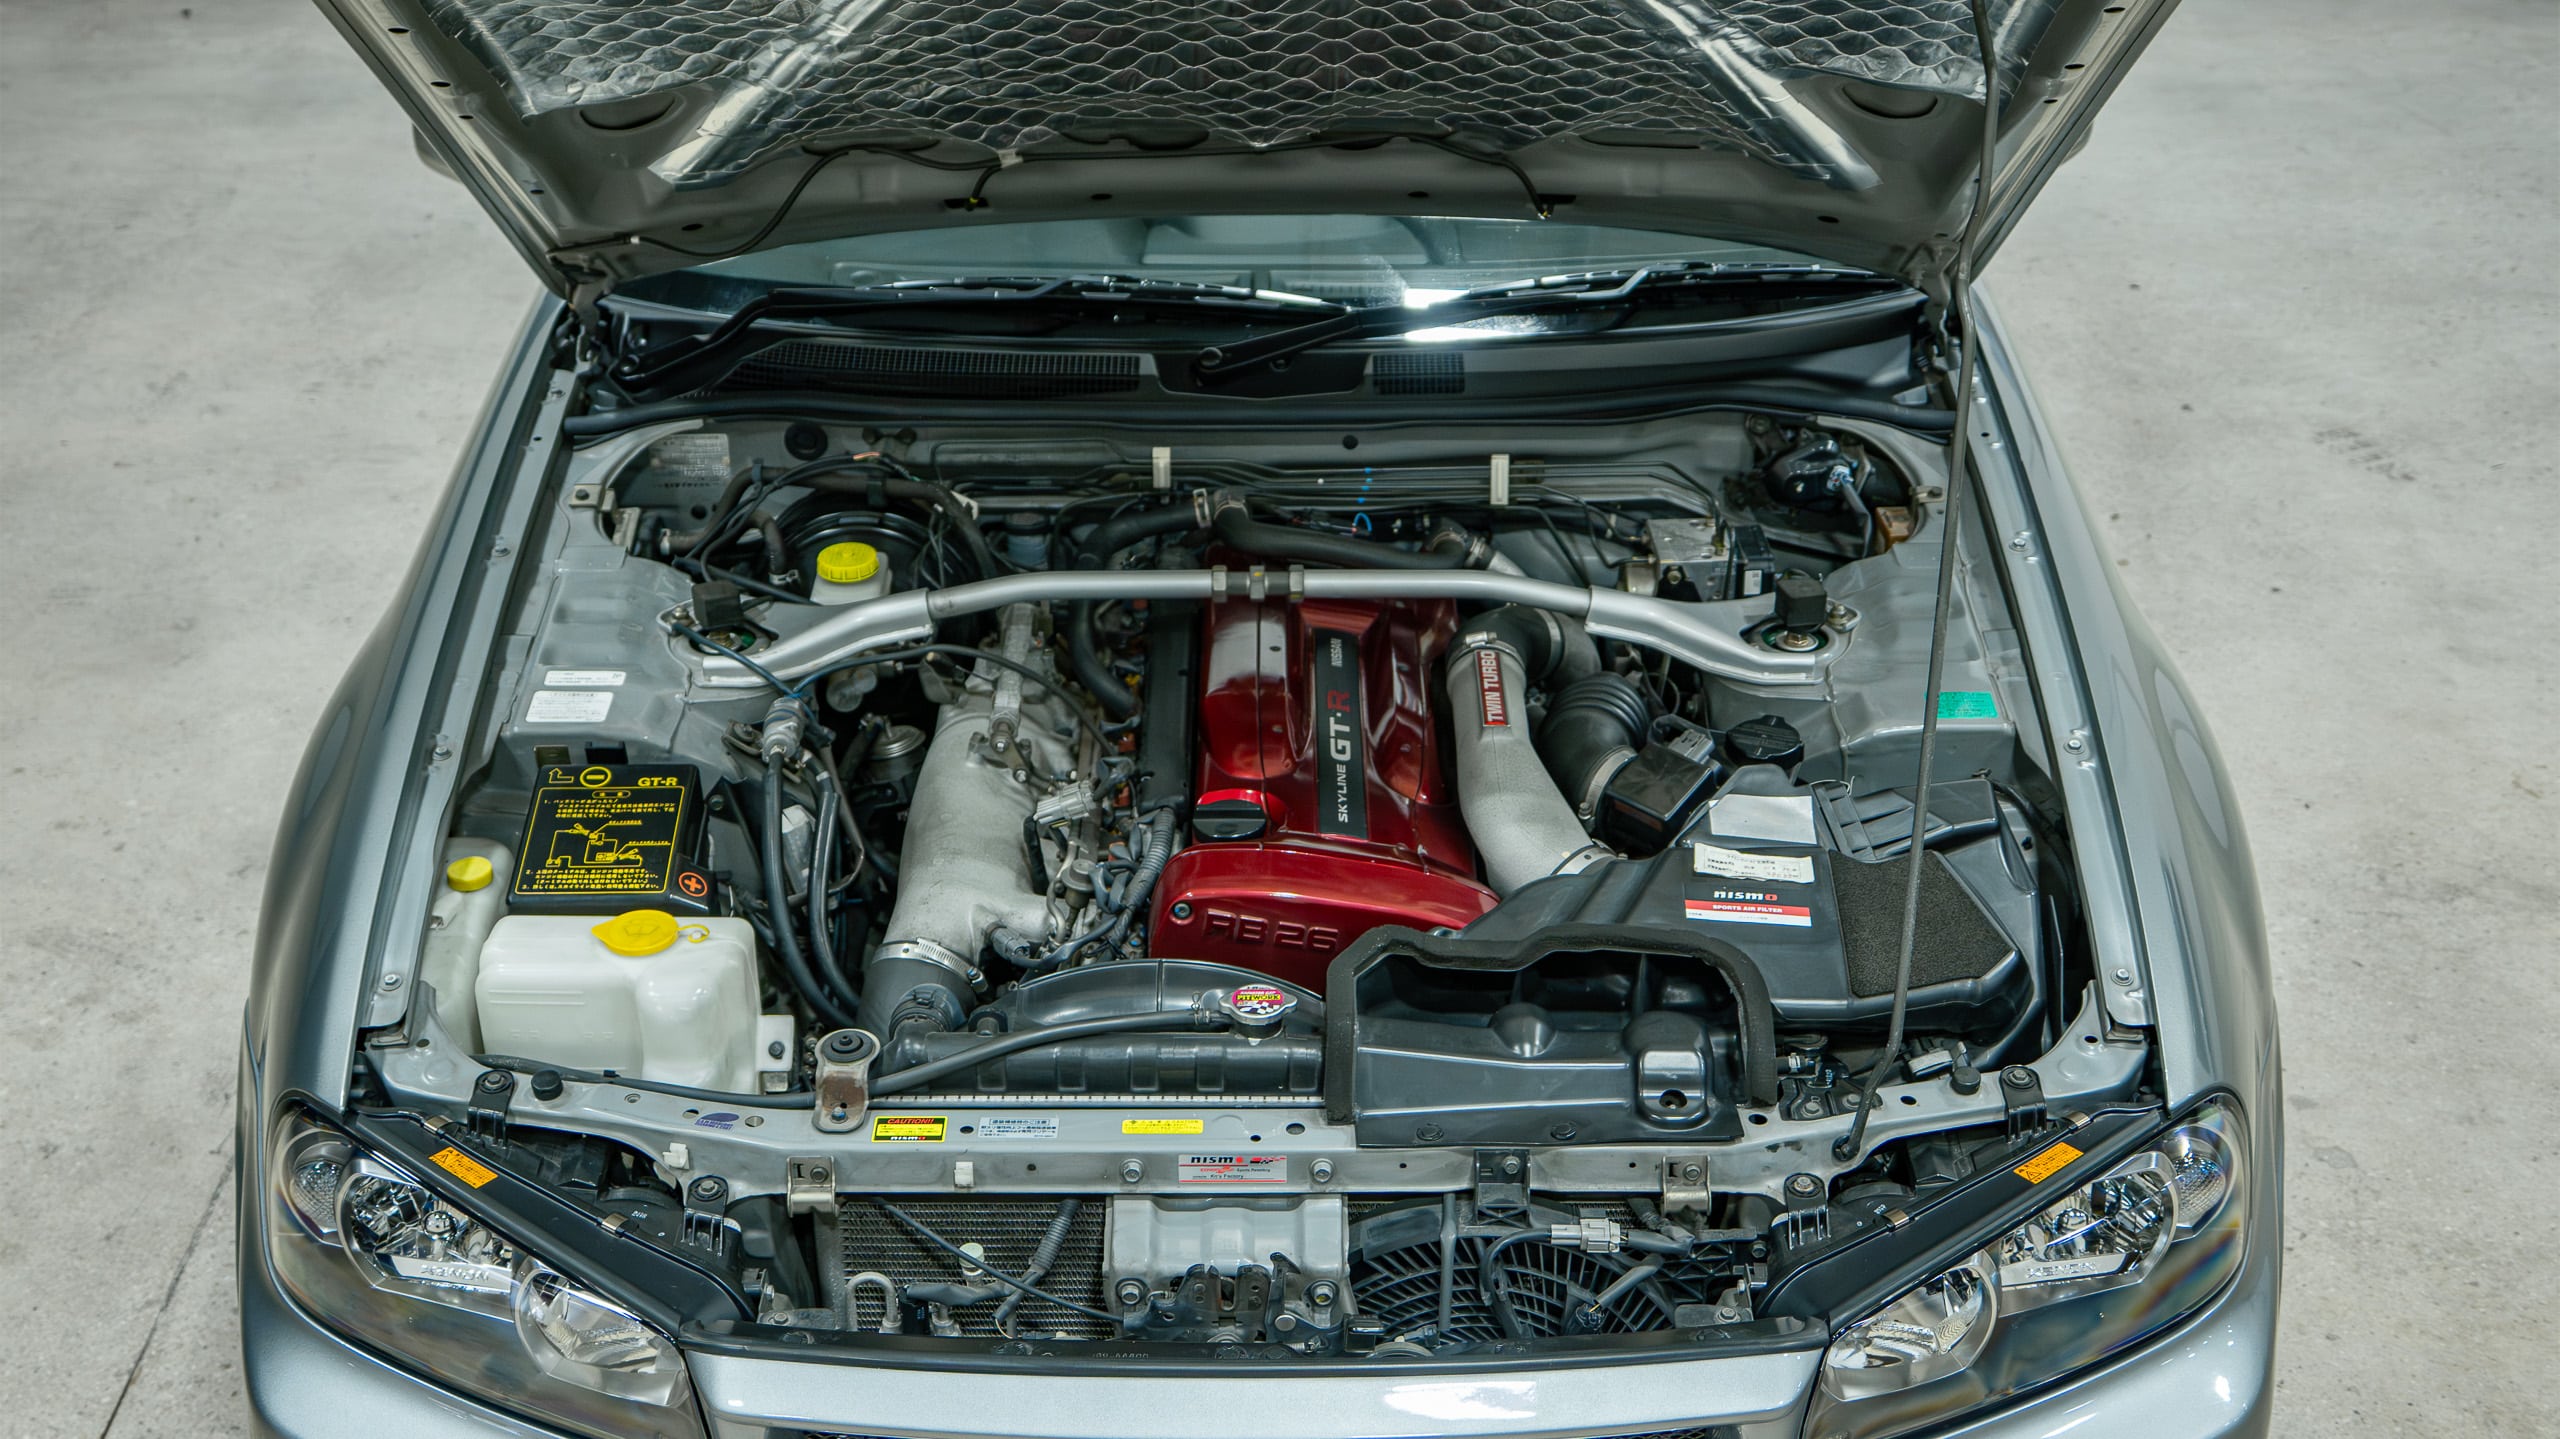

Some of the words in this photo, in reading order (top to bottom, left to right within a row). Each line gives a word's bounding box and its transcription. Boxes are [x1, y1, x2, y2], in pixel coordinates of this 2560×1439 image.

[1330, 637, 1342, 667] NISSAN
[1480, 650, 1500, 690] TURBO
[1484, 691, 1504, 722] TWIN
[637, 776, 678, 787] GT-R
[1336, 764, 1348, 823] SKYLINE
